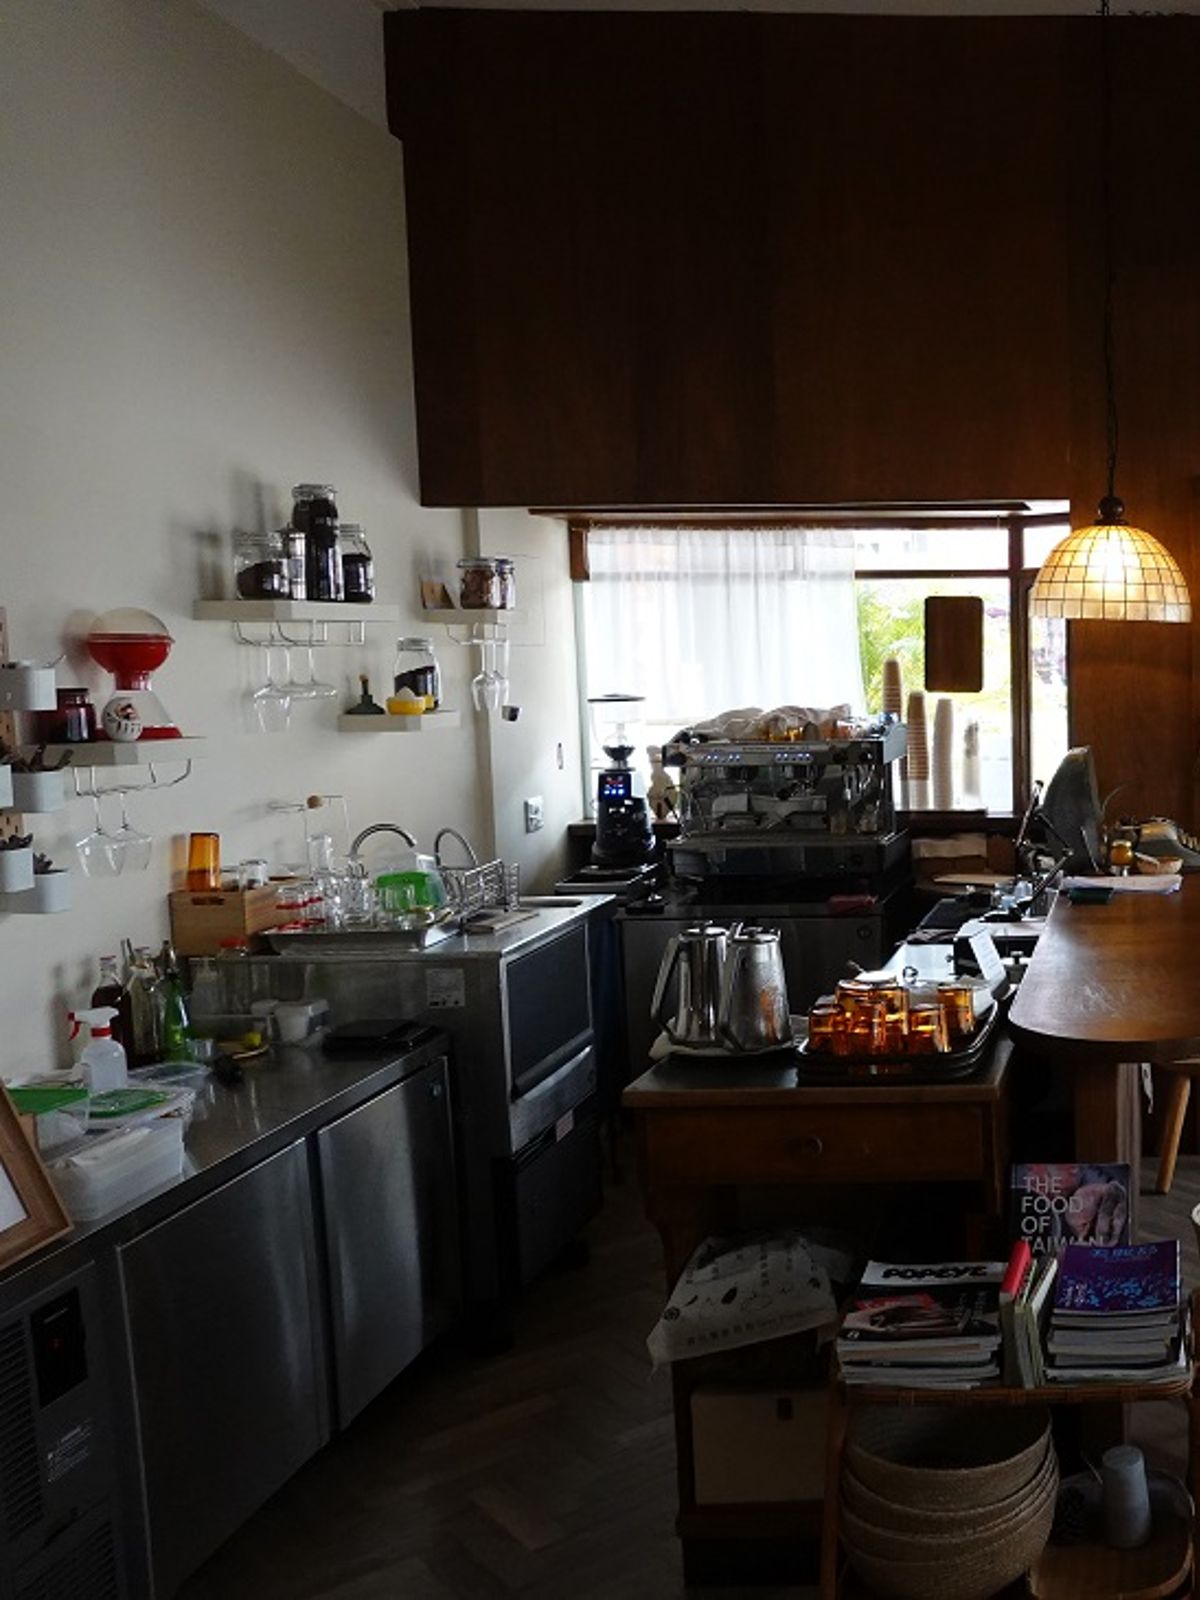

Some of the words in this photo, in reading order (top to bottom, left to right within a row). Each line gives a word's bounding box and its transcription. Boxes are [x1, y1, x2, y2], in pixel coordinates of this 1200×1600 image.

[1023, 1176, 1062, 1194] THE
[1021, 1196, 1084, 1213] FOOD
[1021, 1215, 1050, 1234] OF
[883, 1266, 987, 1279] POPEYE
